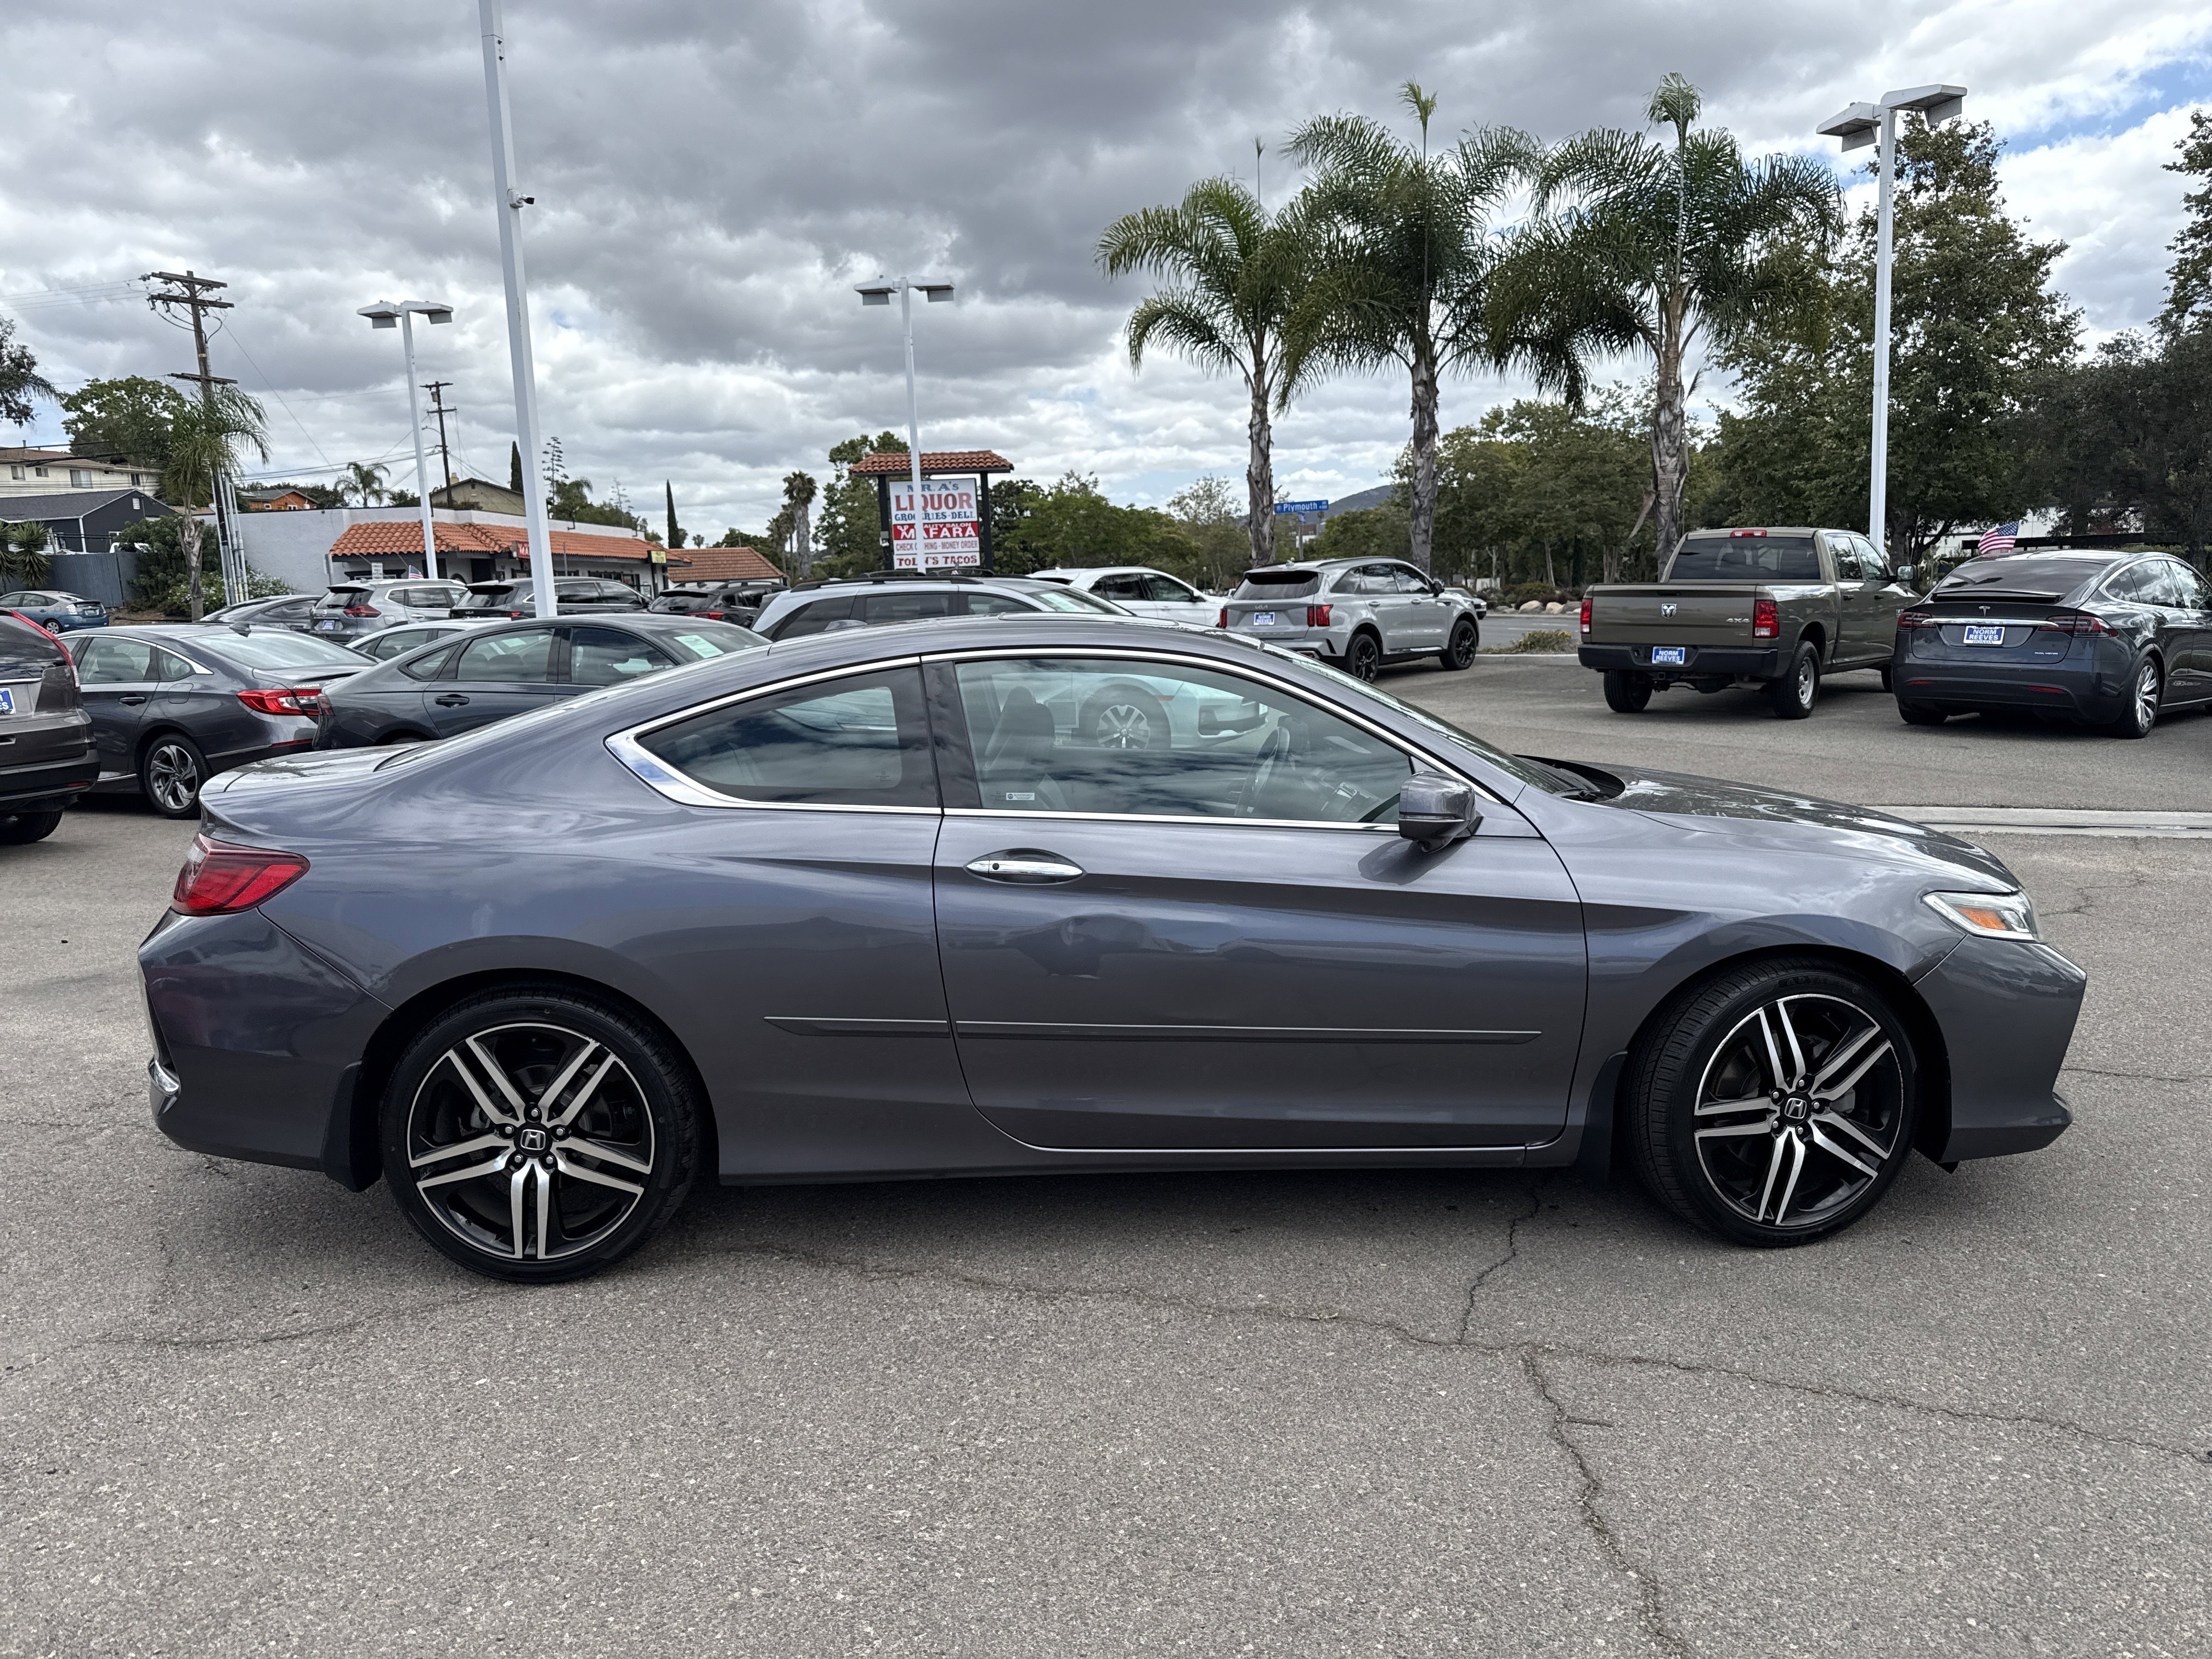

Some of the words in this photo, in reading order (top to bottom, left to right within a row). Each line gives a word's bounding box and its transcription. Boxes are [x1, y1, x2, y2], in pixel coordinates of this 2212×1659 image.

[1283, 502, 1317, 512] Plymouth
[915, 542, 937, 550] CHING
[941, 541, 959, 549] MONEY
[961, 540, 978, 549] ORDER
[943, 555, 977, 565] TACOS
